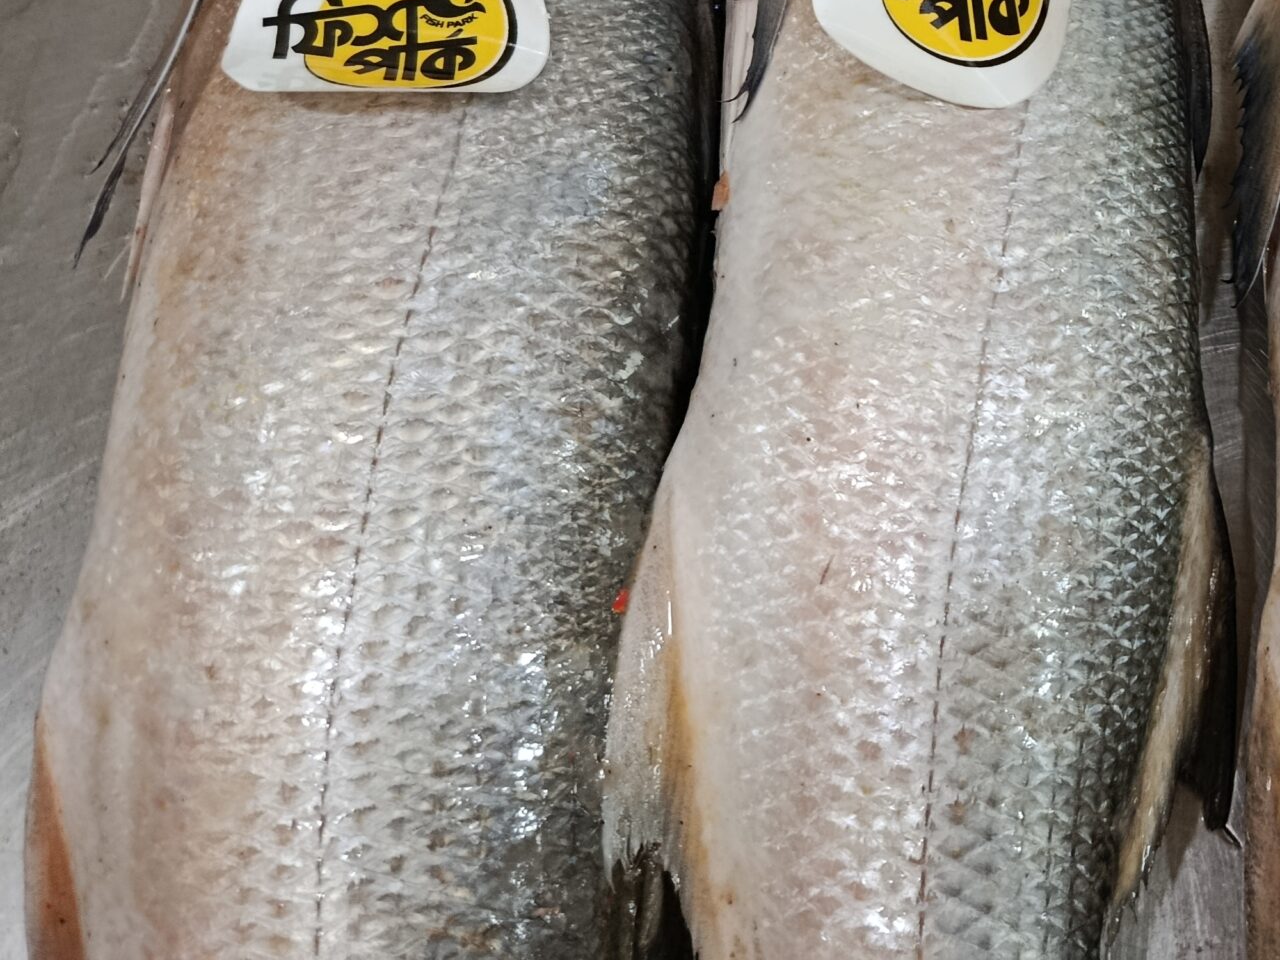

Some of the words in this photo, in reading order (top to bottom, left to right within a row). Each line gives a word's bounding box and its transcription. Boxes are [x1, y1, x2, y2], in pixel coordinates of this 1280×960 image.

[419, 13, 445, 28] FISH
[446, 13, 478, 29] PARK
[343, 28, 477, 81] পার্ক
